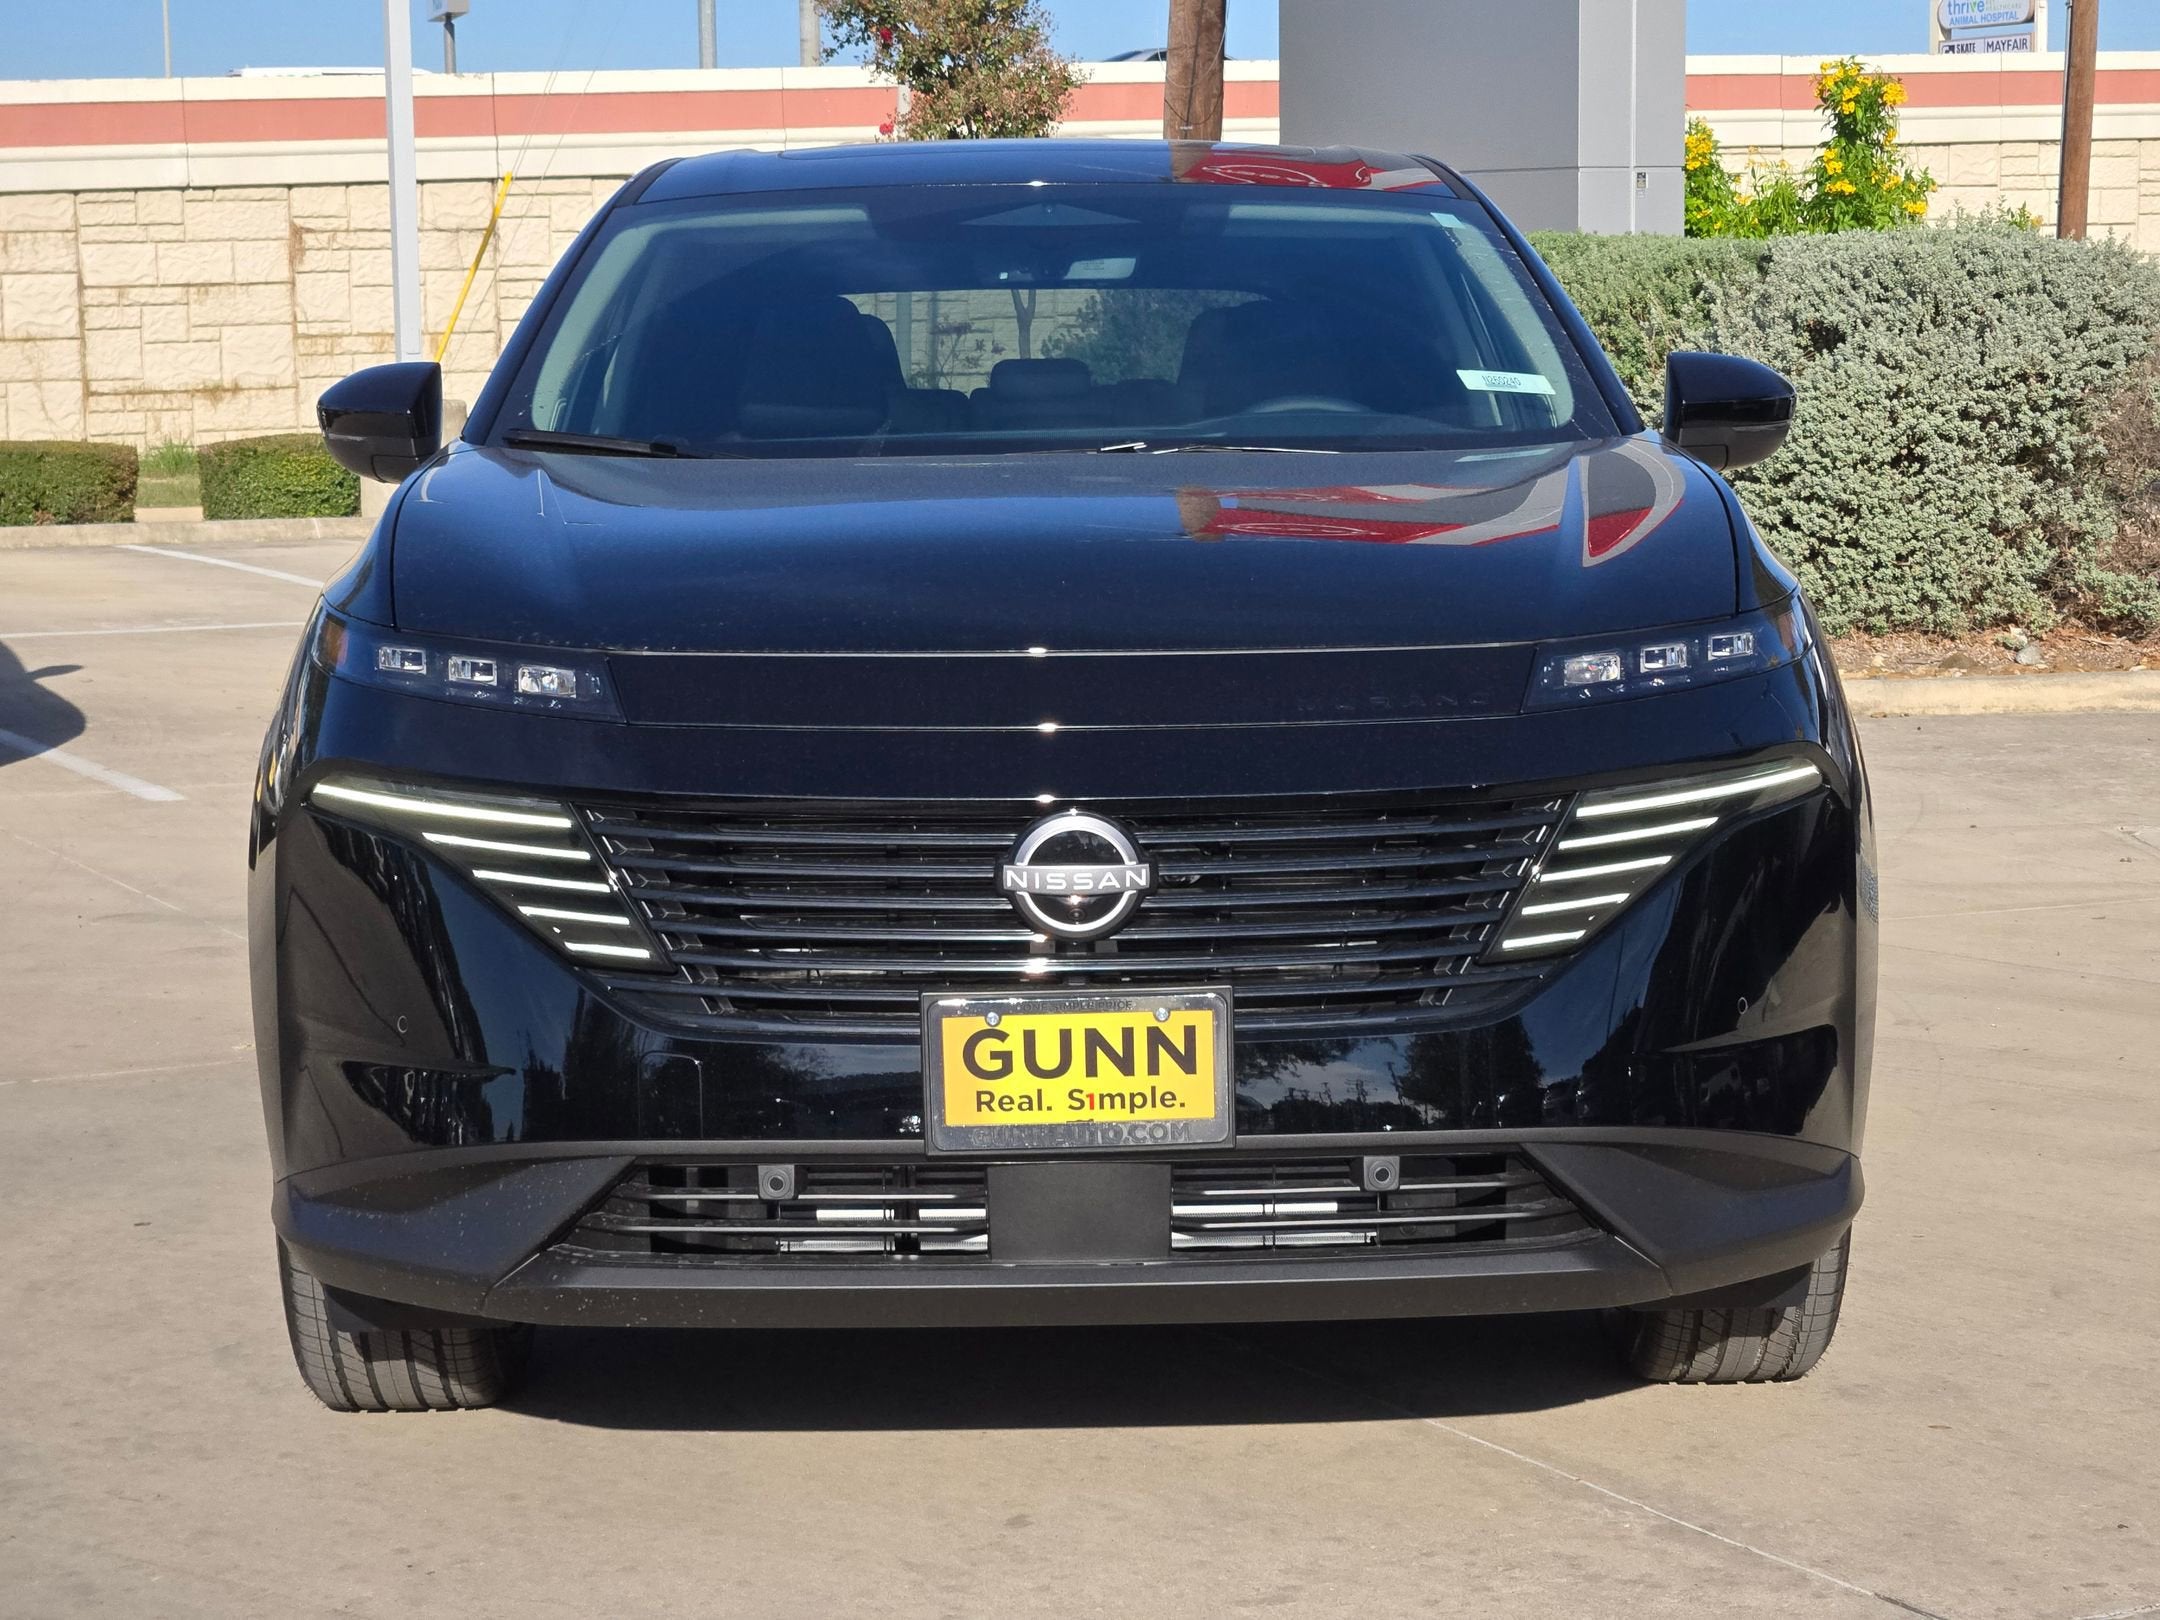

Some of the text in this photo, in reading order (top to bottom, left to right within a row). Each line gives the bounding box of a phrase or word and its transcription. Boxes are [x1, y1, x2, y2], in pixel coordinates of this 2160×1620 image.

[1947, 0, 1985, 15] thrive
[1949, 11, 2018, 26] ANIMAL HOSPITAL
[1956, 42, 1976, 54] SKATE
[1986, 38, 2027, 53] MAYFAIR
[1006, 868, 1147, 890] NISSAN
[962, 1025, 1197, 1080] GUNN
[976, 1088, 1053, 1113] Real.
